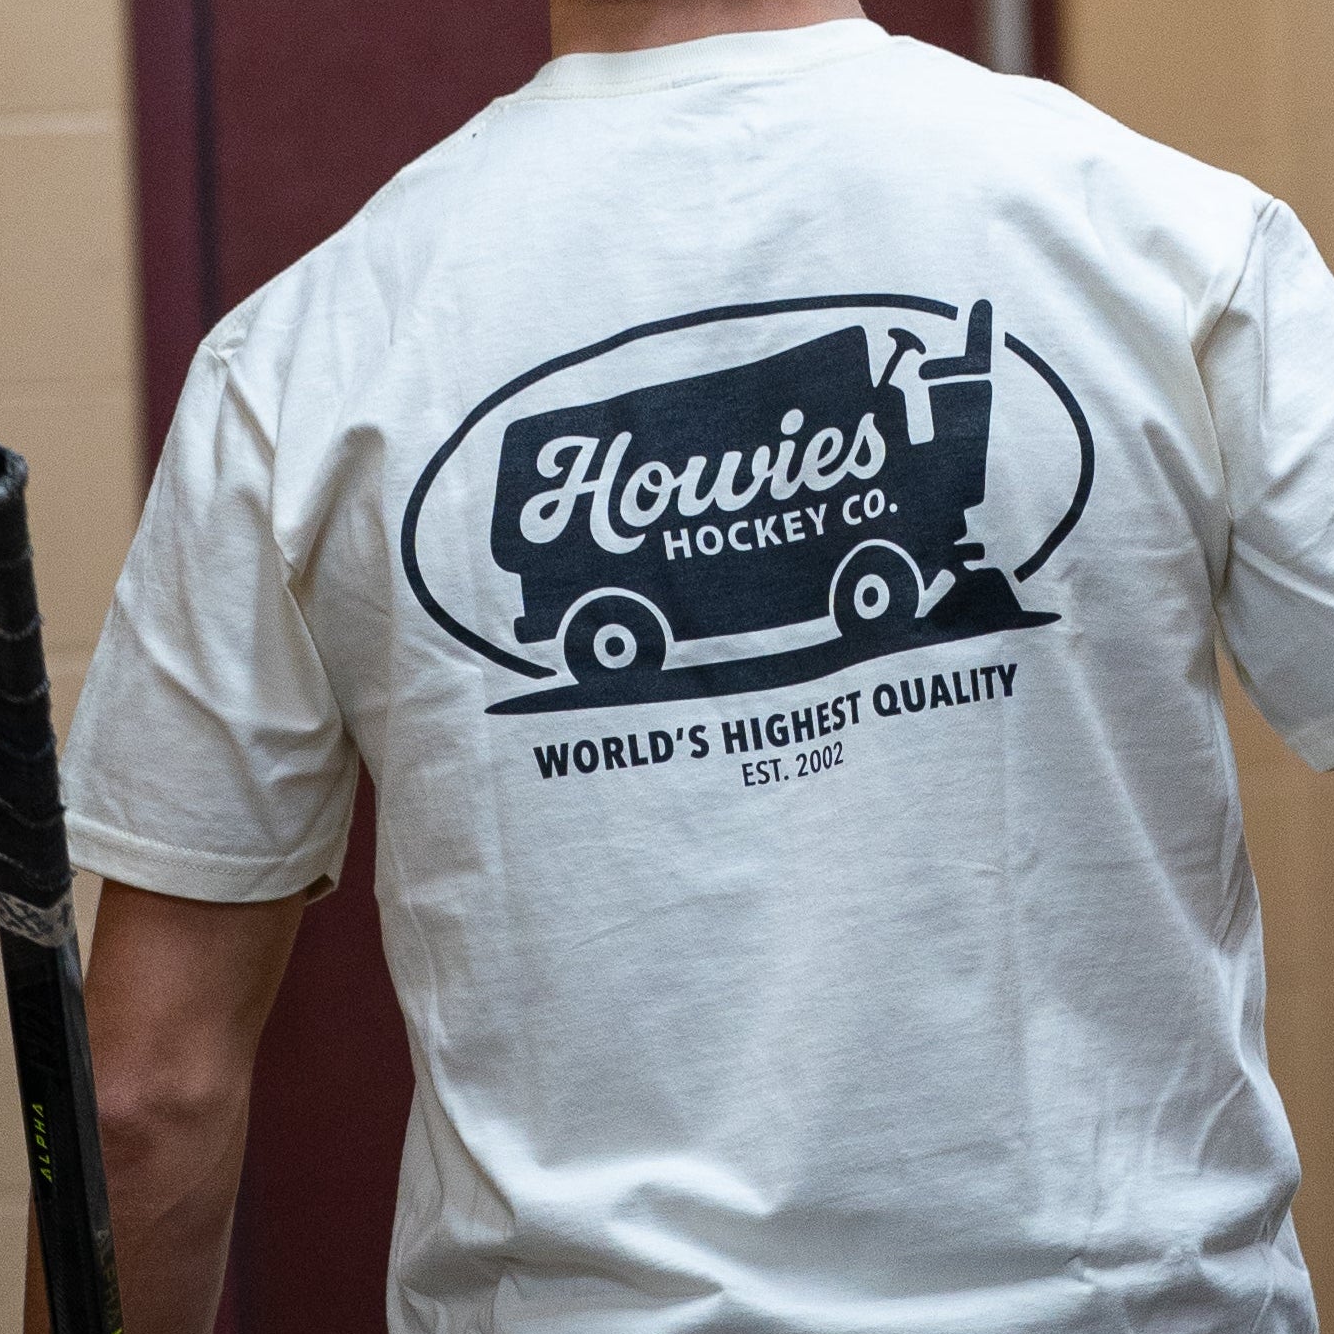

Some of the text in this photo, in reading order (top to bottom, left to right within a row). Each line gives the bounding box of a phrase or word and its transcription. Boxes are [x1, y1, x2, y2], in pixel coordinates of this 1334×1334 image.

[520, 408, 886, 554] Howies
[663, 488, 898, 561] HOCKEY CO.
[533, 663, 1018, 779] WORLD'S HIGHEST QUALITY
[741, 741, 844, 787] EST. 2002
[33, 1102, 55, 1182] ALPHA
